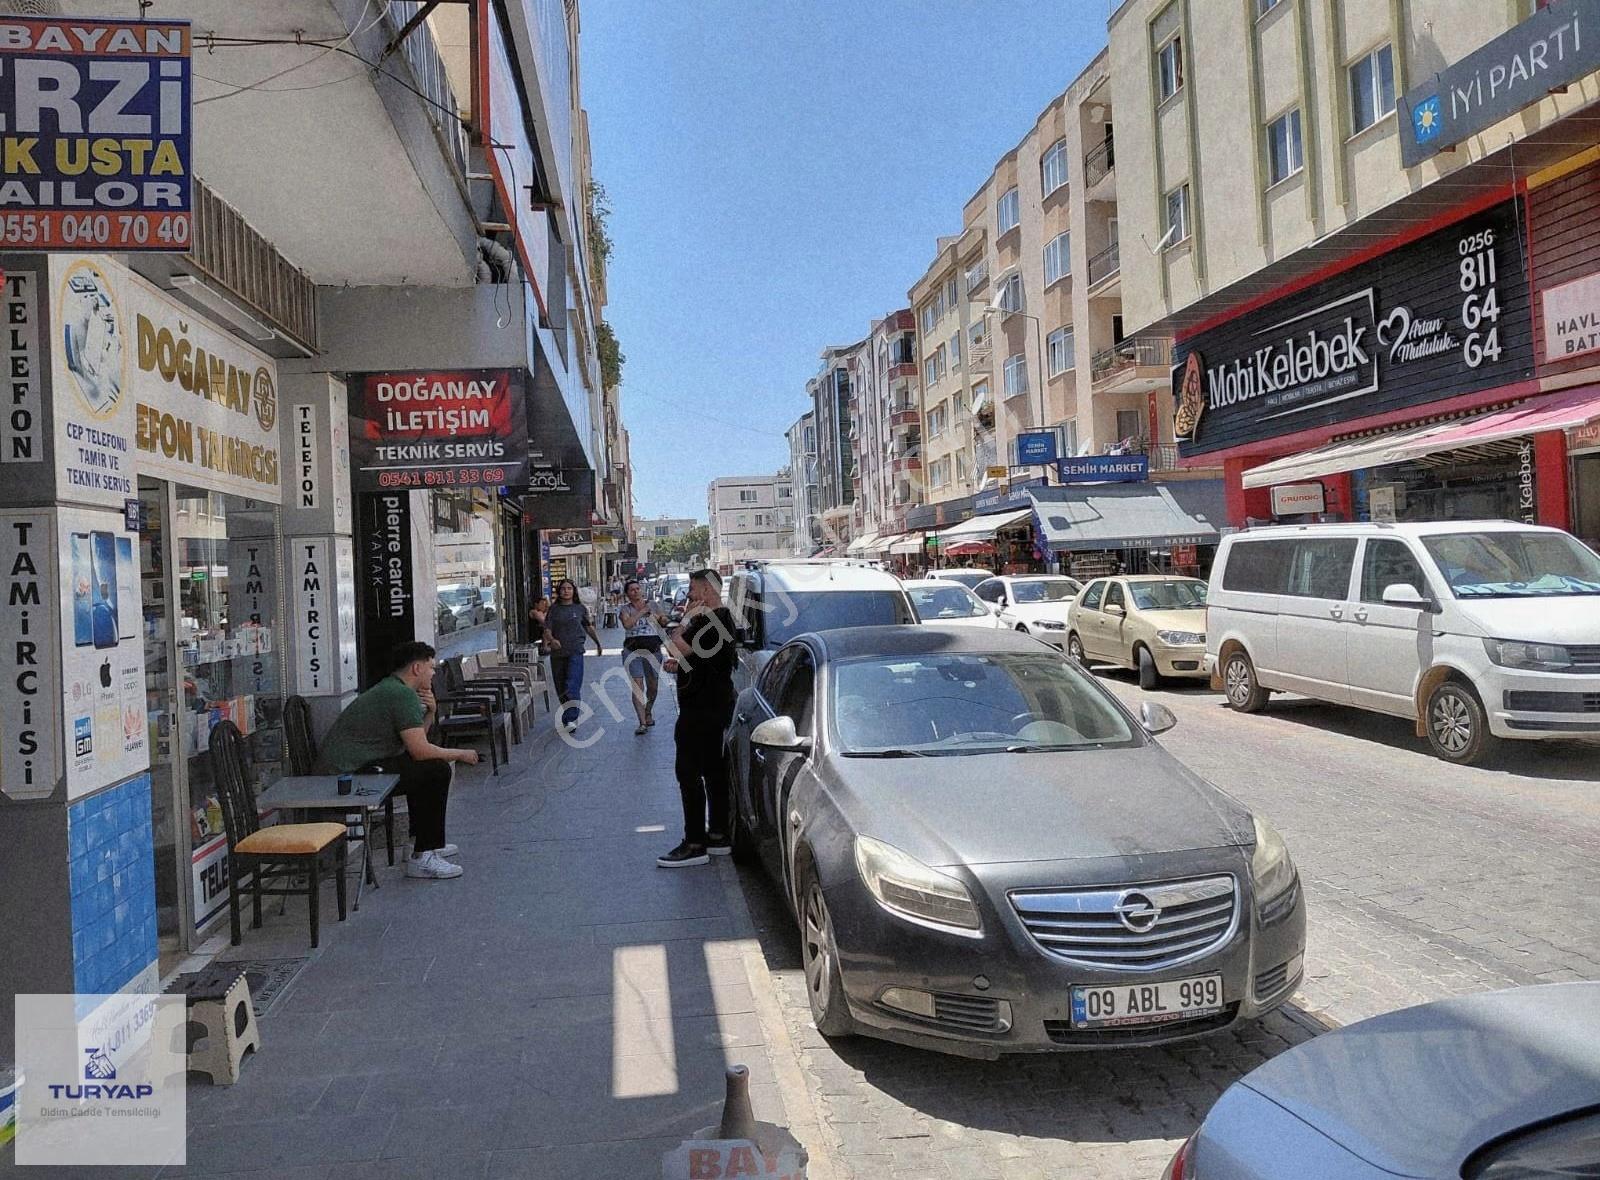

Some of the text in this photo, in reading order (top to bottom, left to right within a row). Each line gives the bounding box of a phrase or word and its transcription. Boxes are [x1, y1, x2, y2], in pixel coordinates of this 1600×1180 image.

[0, 25, 181, 53] BAYAN
[1488, 10, 1581, 100] PARTİ
[0, 58, 182, 135] RZi
[55, 138, 184, 175] USTA
[0, 180, 182, 207] AILOR
[61, 215, 110, 243] 040
[118, 216, 148, 243] 70
[157, 216, 189, 243] 40
[1460, 248, 1496, 292] 811
[1462, 287, 1500, 330] 64
[1463, 327, 1502, 368] 64
[1565, 332, 1600, 354] BAT
[6, 276, 32, 458] TELEFON
[137, 313, 252, 416] DOĞANAY
[377, 377, 497, 402] DOĞANAY
[386, 405, 490, 435] İLETİŞİM
[66, 422, 127, 452] CEP TELEFONU
[376, 439, 505, 461] TEKNİK SERVİS
[78, 447, 119, 471] TAMİR VE
[299, 406, 314, 507] TELEFON
[1063, 462, 1143, 475] SEMİH MARKET
[66, 467, 131, 494] TEKNİK SERVİS
[379, 468, 505, 487] 0541 811 33 69
[1517, 442, 1533, 509] Kelebek
[371, 529, 383, 586] YATAK
[382, 497, 411, 617] pierre cardin
[1164, 537, 1203, 545] MARKET
[1088, 990, 1115, 1017] 09
[1127, 986, 1167, 1014] ABL
[1179, 979, 1217, 1008] 999
